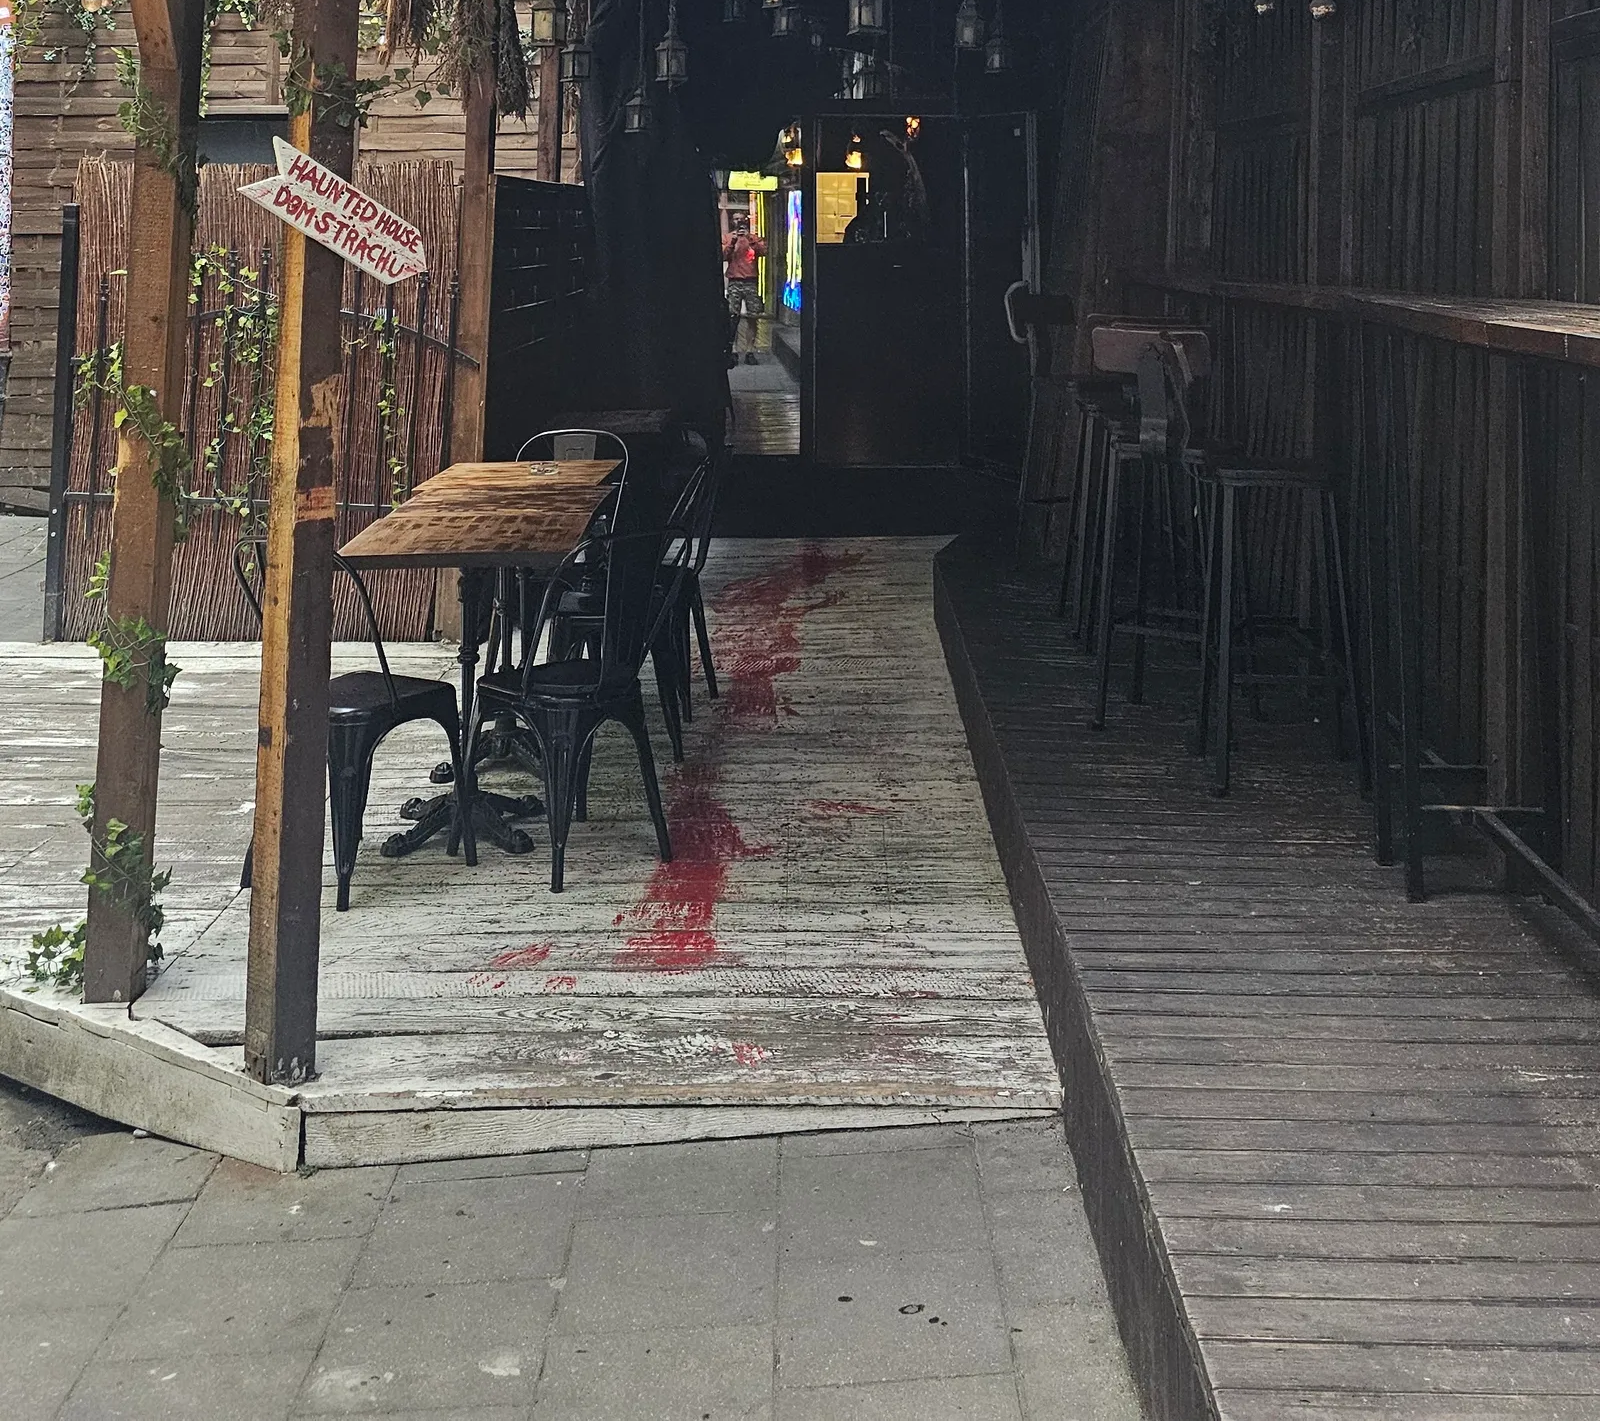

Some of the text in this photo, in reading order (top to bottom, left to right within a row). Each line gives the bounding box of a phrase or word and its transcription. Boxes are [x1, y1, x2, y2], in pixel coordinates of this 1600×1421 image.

[273, 185, 405, 278] DOM STRACHU
[288, 154, 422, 254] HAUNTED HOUSE
